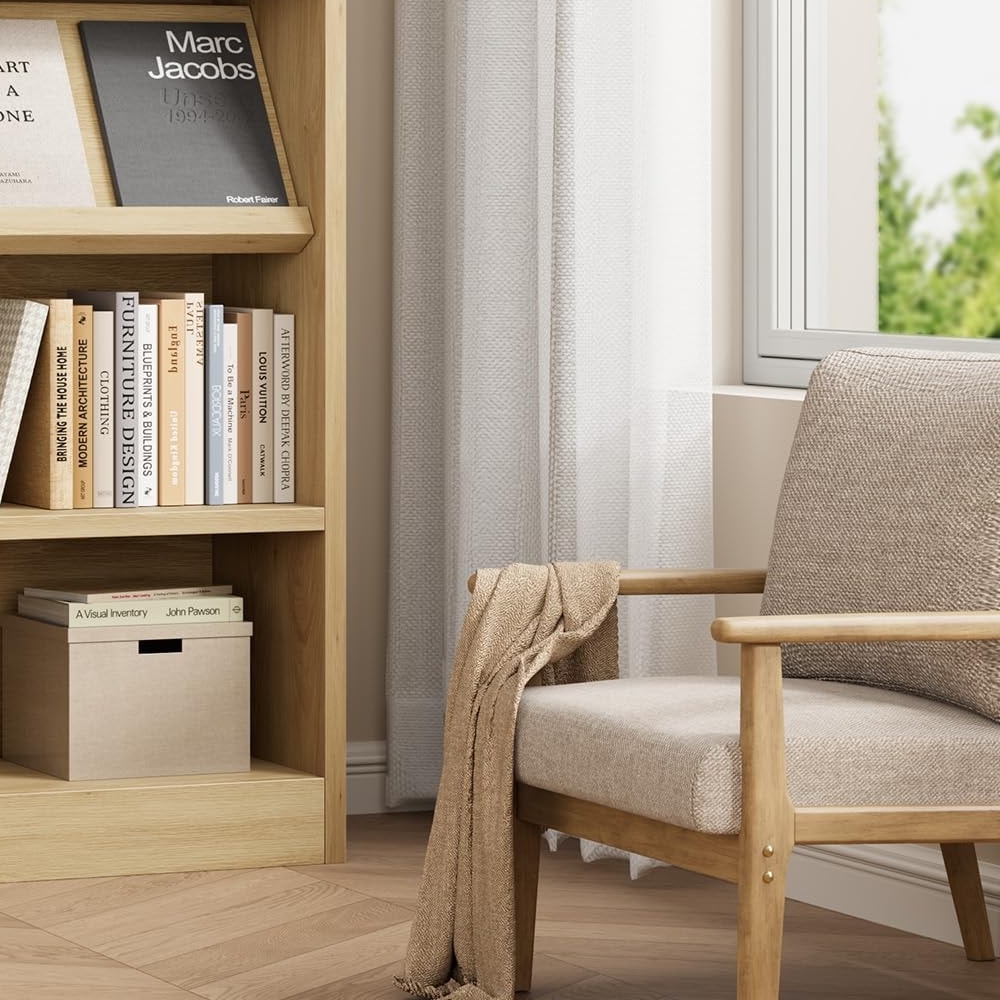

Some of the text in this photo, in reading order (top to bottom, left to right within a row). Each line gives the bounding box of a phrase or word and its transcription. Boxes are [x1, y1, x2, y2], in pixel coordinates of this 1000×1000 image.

[165, 30, 244, 53] Marc
[148, 56, 256, 80] Jacobs
[6, 85, 19, 96] A
[226, 195, 278, 204] Robert Fairer
[142, 343, 152, 407] BLUEPRINTS
[227, 364, 234, 373] To
[227, 375, 234, 388] Be
[122, 296, 135, 505] FURNITURE DESIGN
[259, 352, 267, 424] LOUIS VUITTON
[56, 346, 68, 462] BRINGING THE HOUSE HOME
[78, 338, 88, 468] MODERN ARCHITECTURE
[100, 370, 110, 435] CLOTHING
[142, 409, 152, 418] &
[240, 390, 250, 419] Paris
[281, 328, 290, 491] AFTERWORD BY DEEPAK CHOPRA
[142, 421, 152, 477] BUILDINGS
[76, 608, 148, 619] A Visual Inventory
[166, 607, 221, 617] John Pawson
